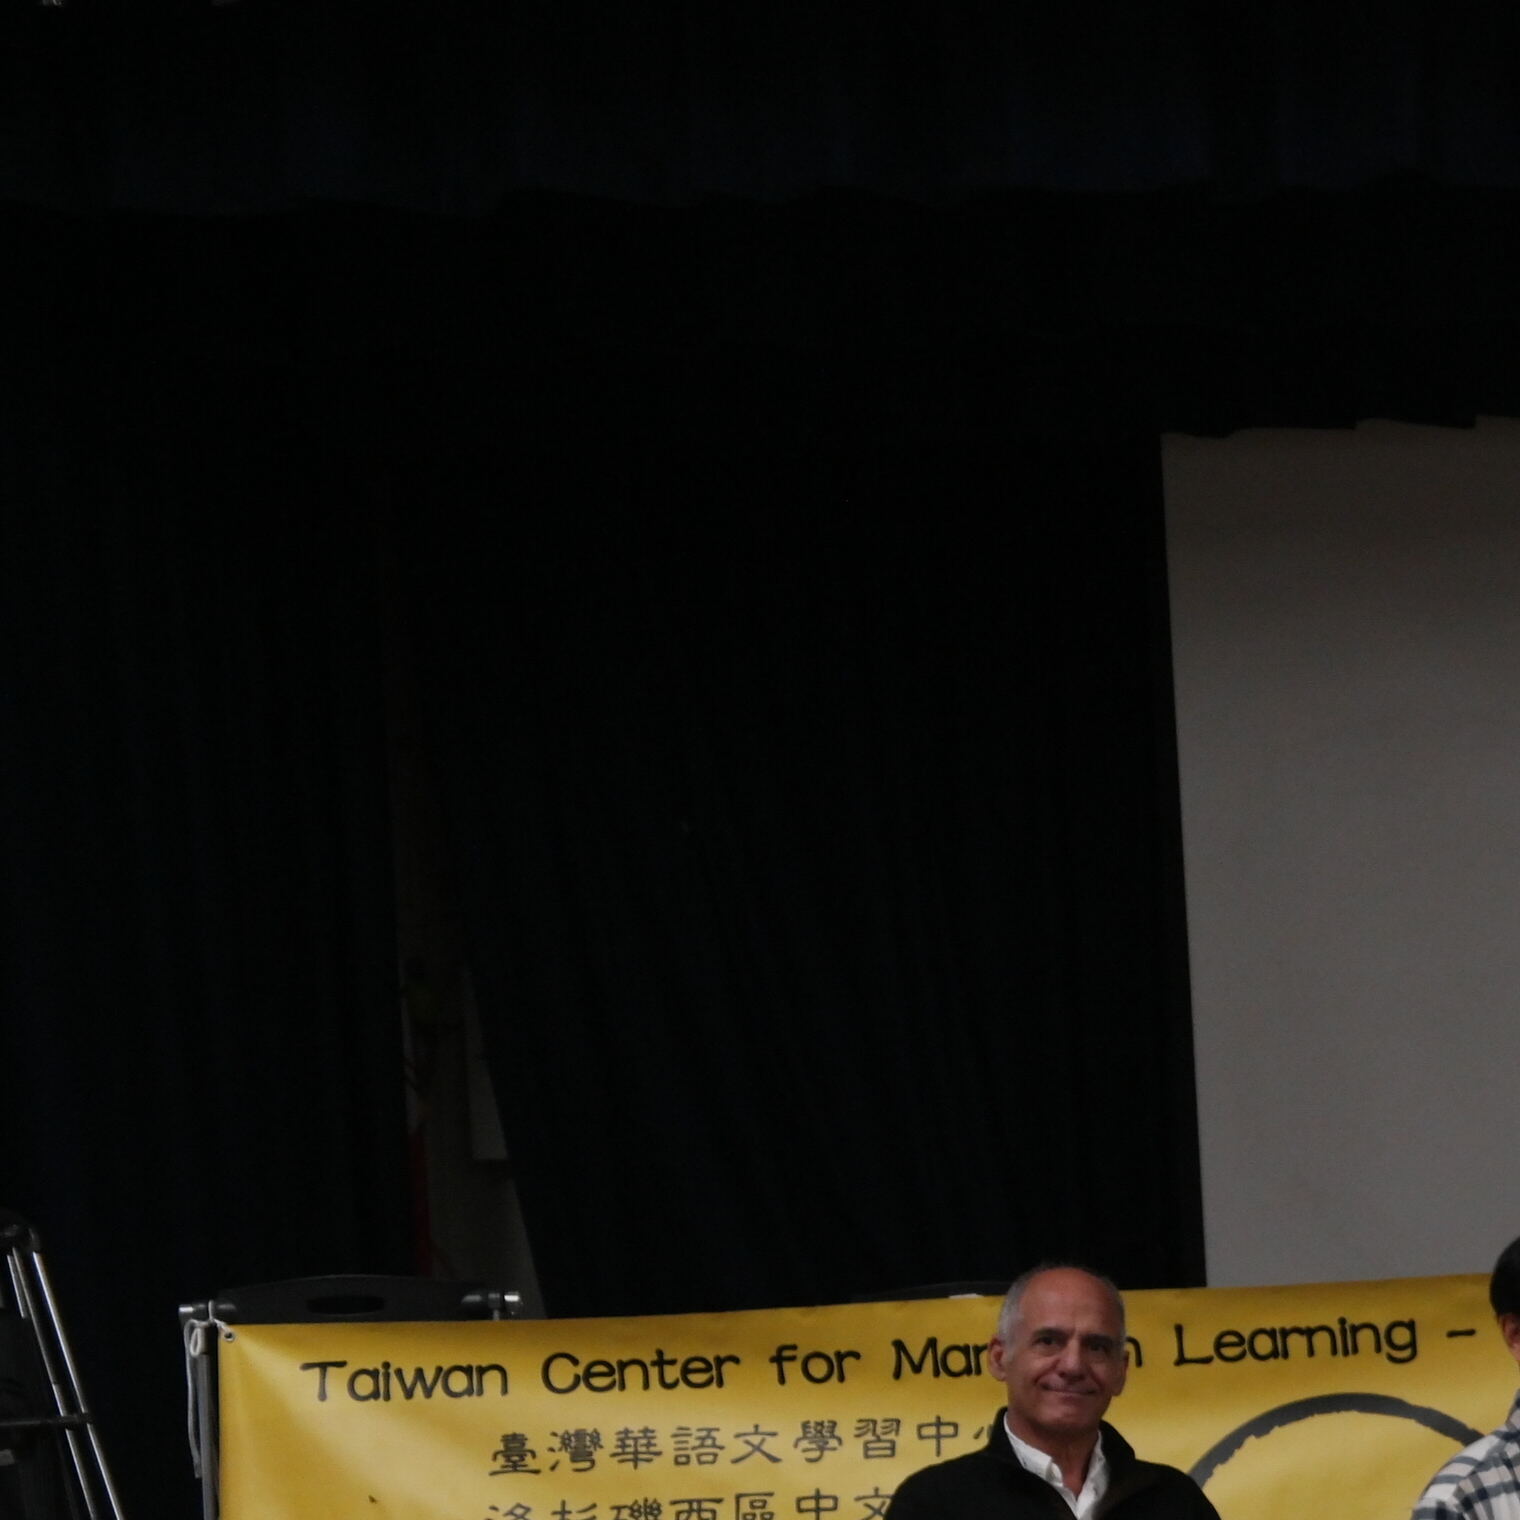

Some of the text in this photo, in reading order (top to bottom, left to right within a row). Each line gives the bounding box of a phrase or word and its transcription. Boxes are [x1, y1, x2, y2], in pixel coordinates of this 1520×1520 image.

[299, 1360, 509, 1401] Taiwan
[541, 1348, 740, 1394] Center
[769, 1344, 862, 1386] for
[1173, 1316, 1419, 1365] Learning
